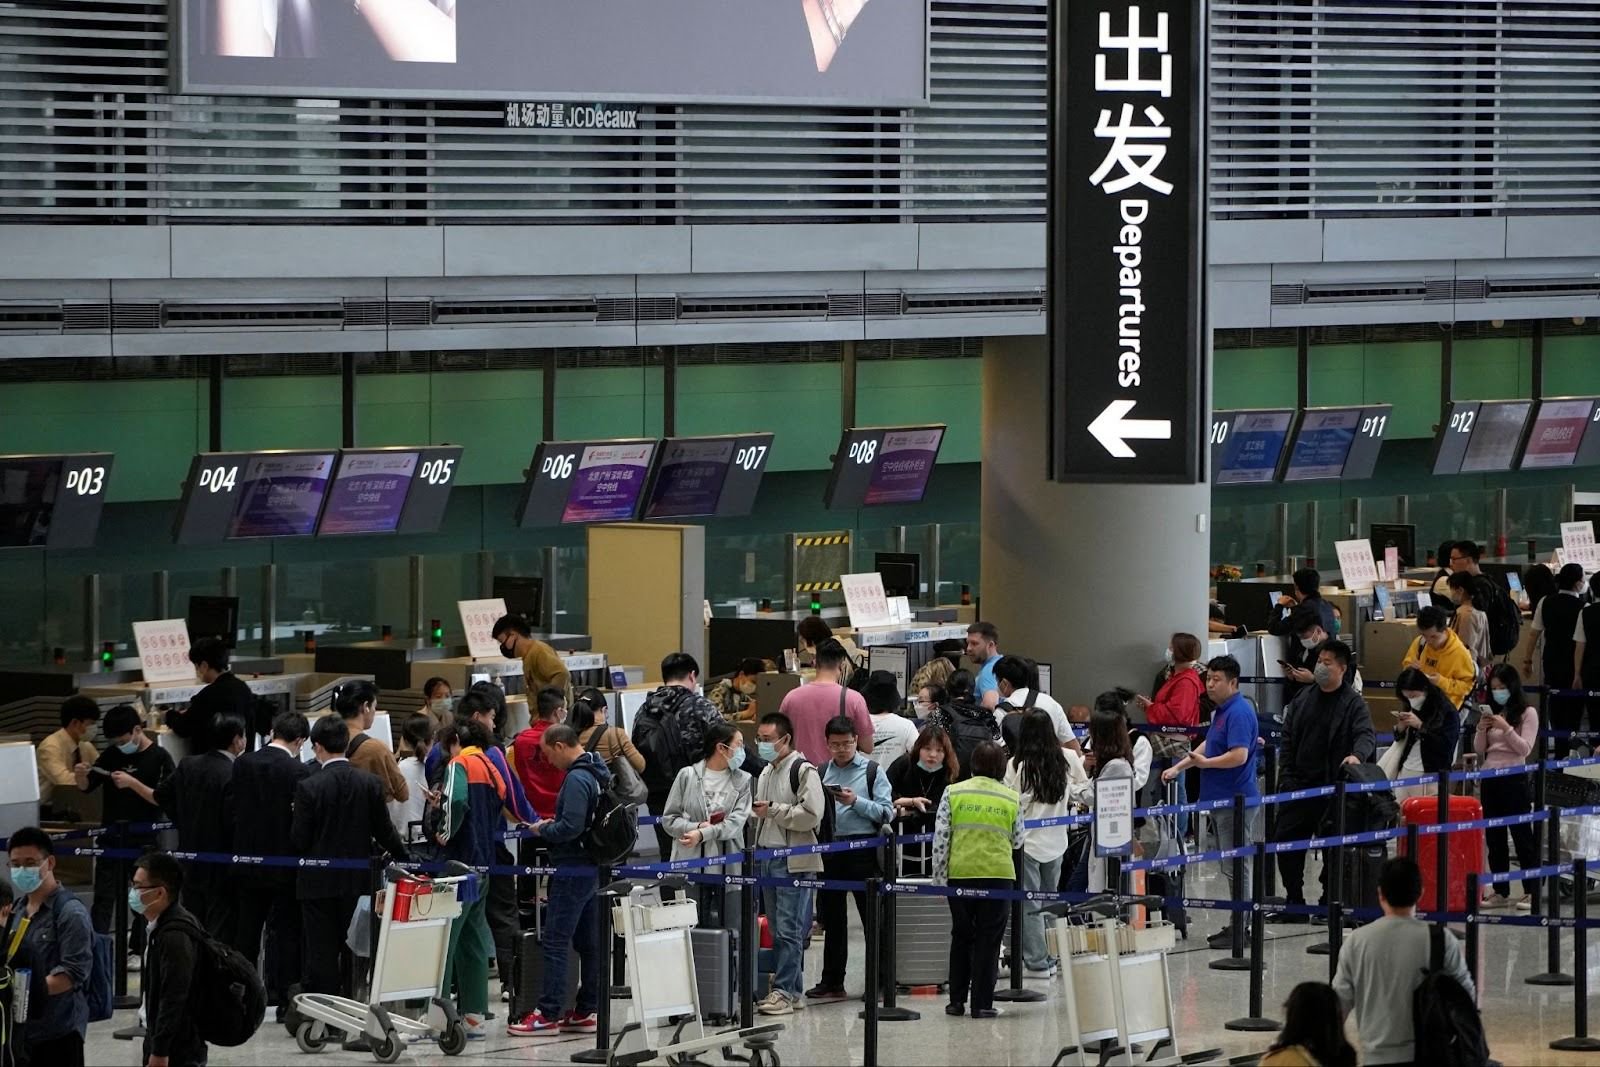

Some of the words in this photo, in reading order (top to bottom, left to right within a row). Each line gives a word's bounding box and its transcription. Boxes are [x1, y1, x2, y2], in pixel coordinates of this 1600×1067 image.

[1089, 6, 1173, 194] 出发
[507, 103, 565, 127] 机场动量
[566, 106, 636, 128] JCDecaux
[1113, 200, 1148, 388] Departures
[1211, 421, 1229, 444] 10
[1362, 415, 1386, 438] D11
[1451, 411, 1474, 433] D12
[736, 446, 767, 471] D07
[849, 439, 877, 464] D08
[420, 459, 454, 485] D05
[542, 454, 575, 479] D06
[66, 466, 105, 495] D03
[199, 466, 238, 493] D04
